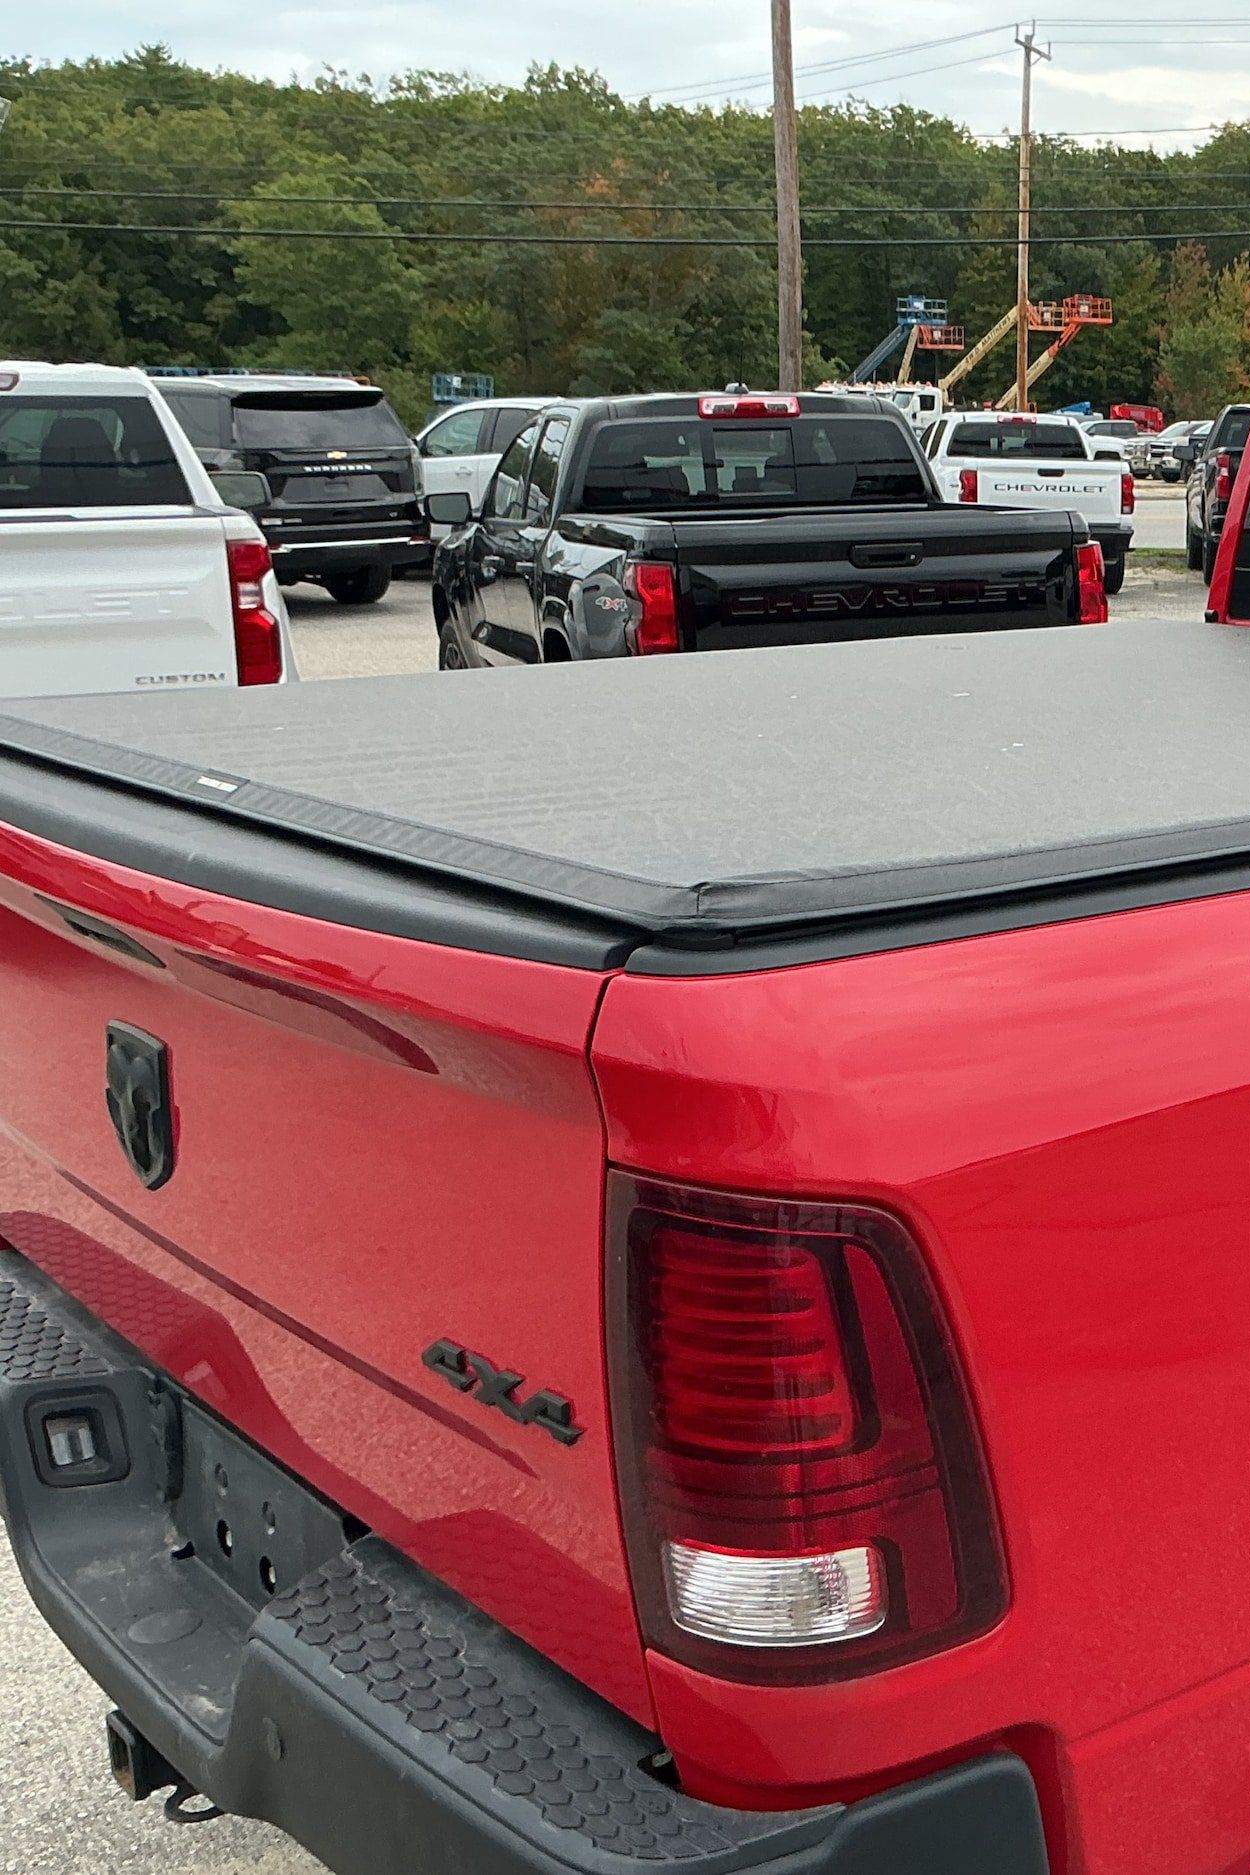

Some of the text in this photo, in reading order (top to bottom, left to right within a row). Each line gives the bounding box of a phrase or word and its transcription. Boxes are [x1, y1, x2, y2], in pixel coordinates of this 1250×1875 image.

[993, 483, 1107, 493] CHEVROLET
[731, 582, 1042, 615] CHEVROLET
[135, 672, 226, 686] CUSTOM
